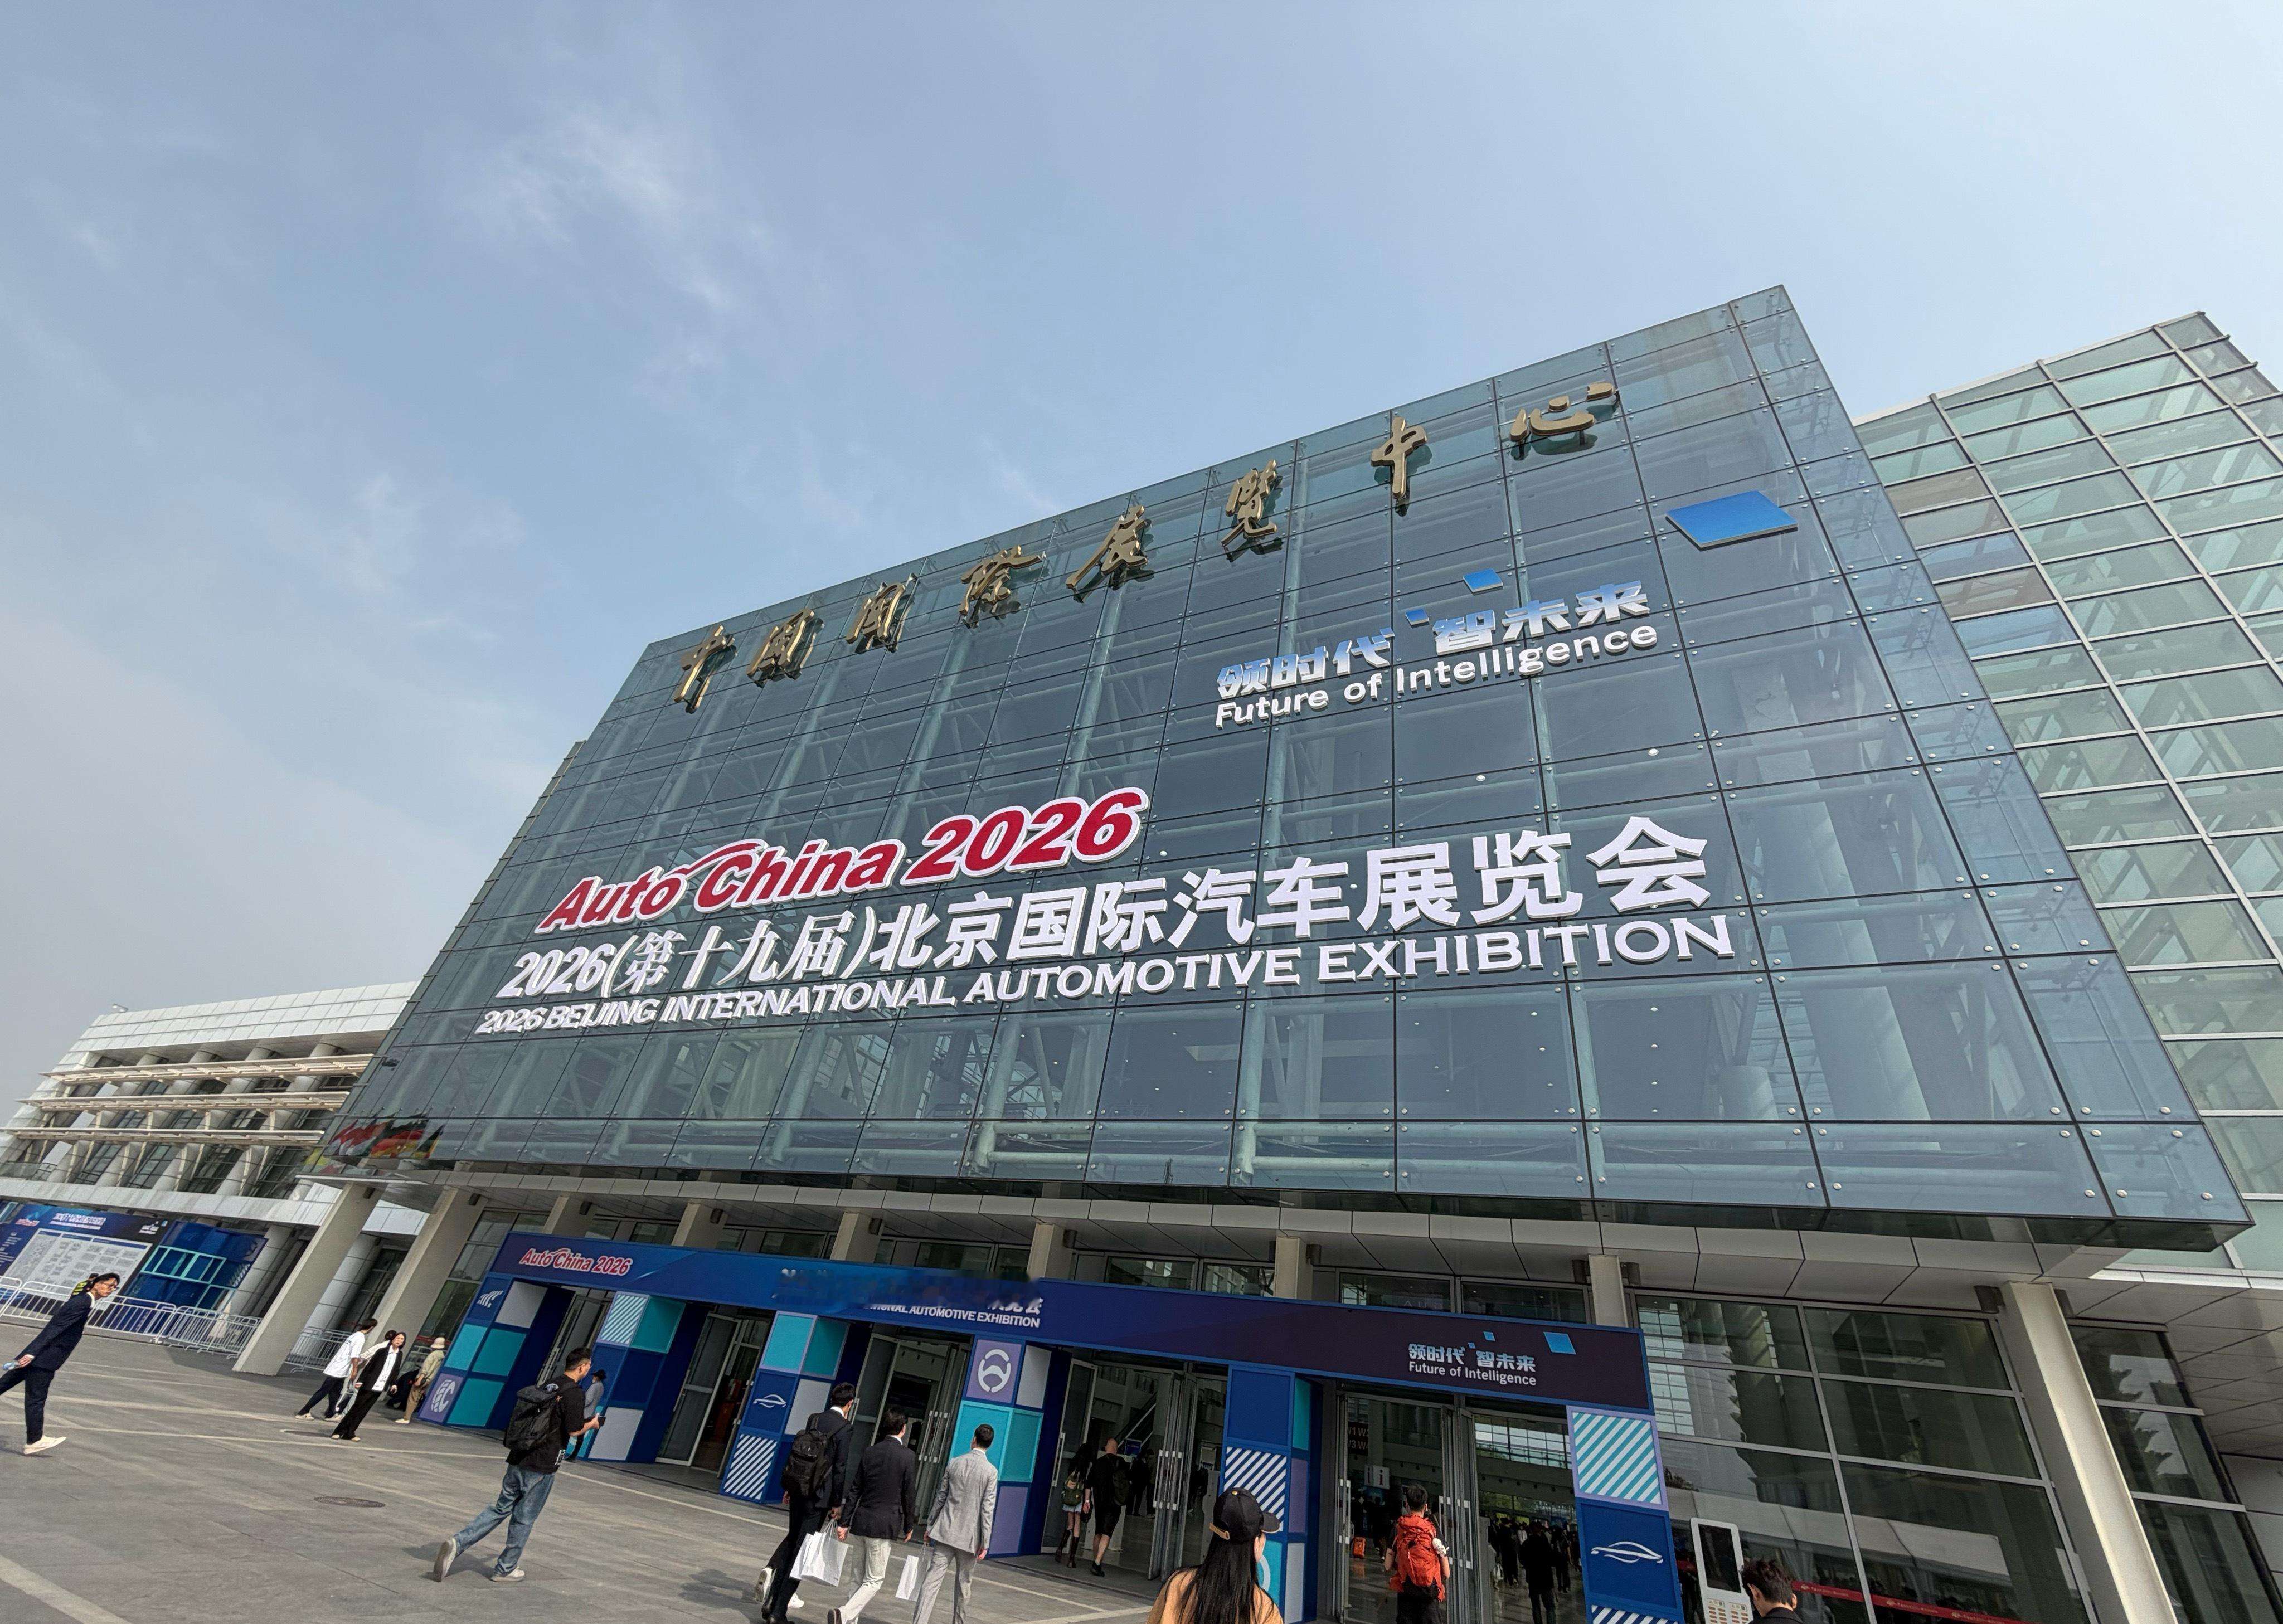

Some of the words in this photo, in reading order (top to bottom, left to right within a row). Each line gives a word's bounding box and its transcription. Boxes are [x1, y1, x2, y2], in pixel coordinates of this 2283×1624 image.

[1216, 628, 1395, 700] 领时代
[1432, 581, 1650, 656] 智未来
[1215, 687, 1329, 729] Future
[1343, 675, 1385, 704] of
[1396, 623, 1658, 696] Intelligence
[533, 864, 689, 936] Auto
[693, 838, 907, 915] China
[899, 786, 1150, 887] 2026
[474, 1007, 546, 1035] 2026
[542, 995, 660, 1032] BEIJING
[658, 974, 956, 1023] INTERNATIONAL
[962, 946, 1303, 1004] AUTOMOTIVE
[1318, 914, 1736, 983] EXHIBITION
[519, 1248, 553, 1267] Auto
[553, 1248, 595, 1272] China
[591, 1255, 633, 1276] 2026
[909, 1305, 976, 1321] AUTOMOTIVE
[977, 1312, 1041, 1328] EXHIBITION
[1408, 1343, 1465, 1365] 领时代
[1476, 1350, 1536, 1372] 智未来
[1408, 1361, 1445, 1375] Future
[1449, 1366, 1461, 1377] of
[1465, 1367, 1537, 1386] Intelligence
